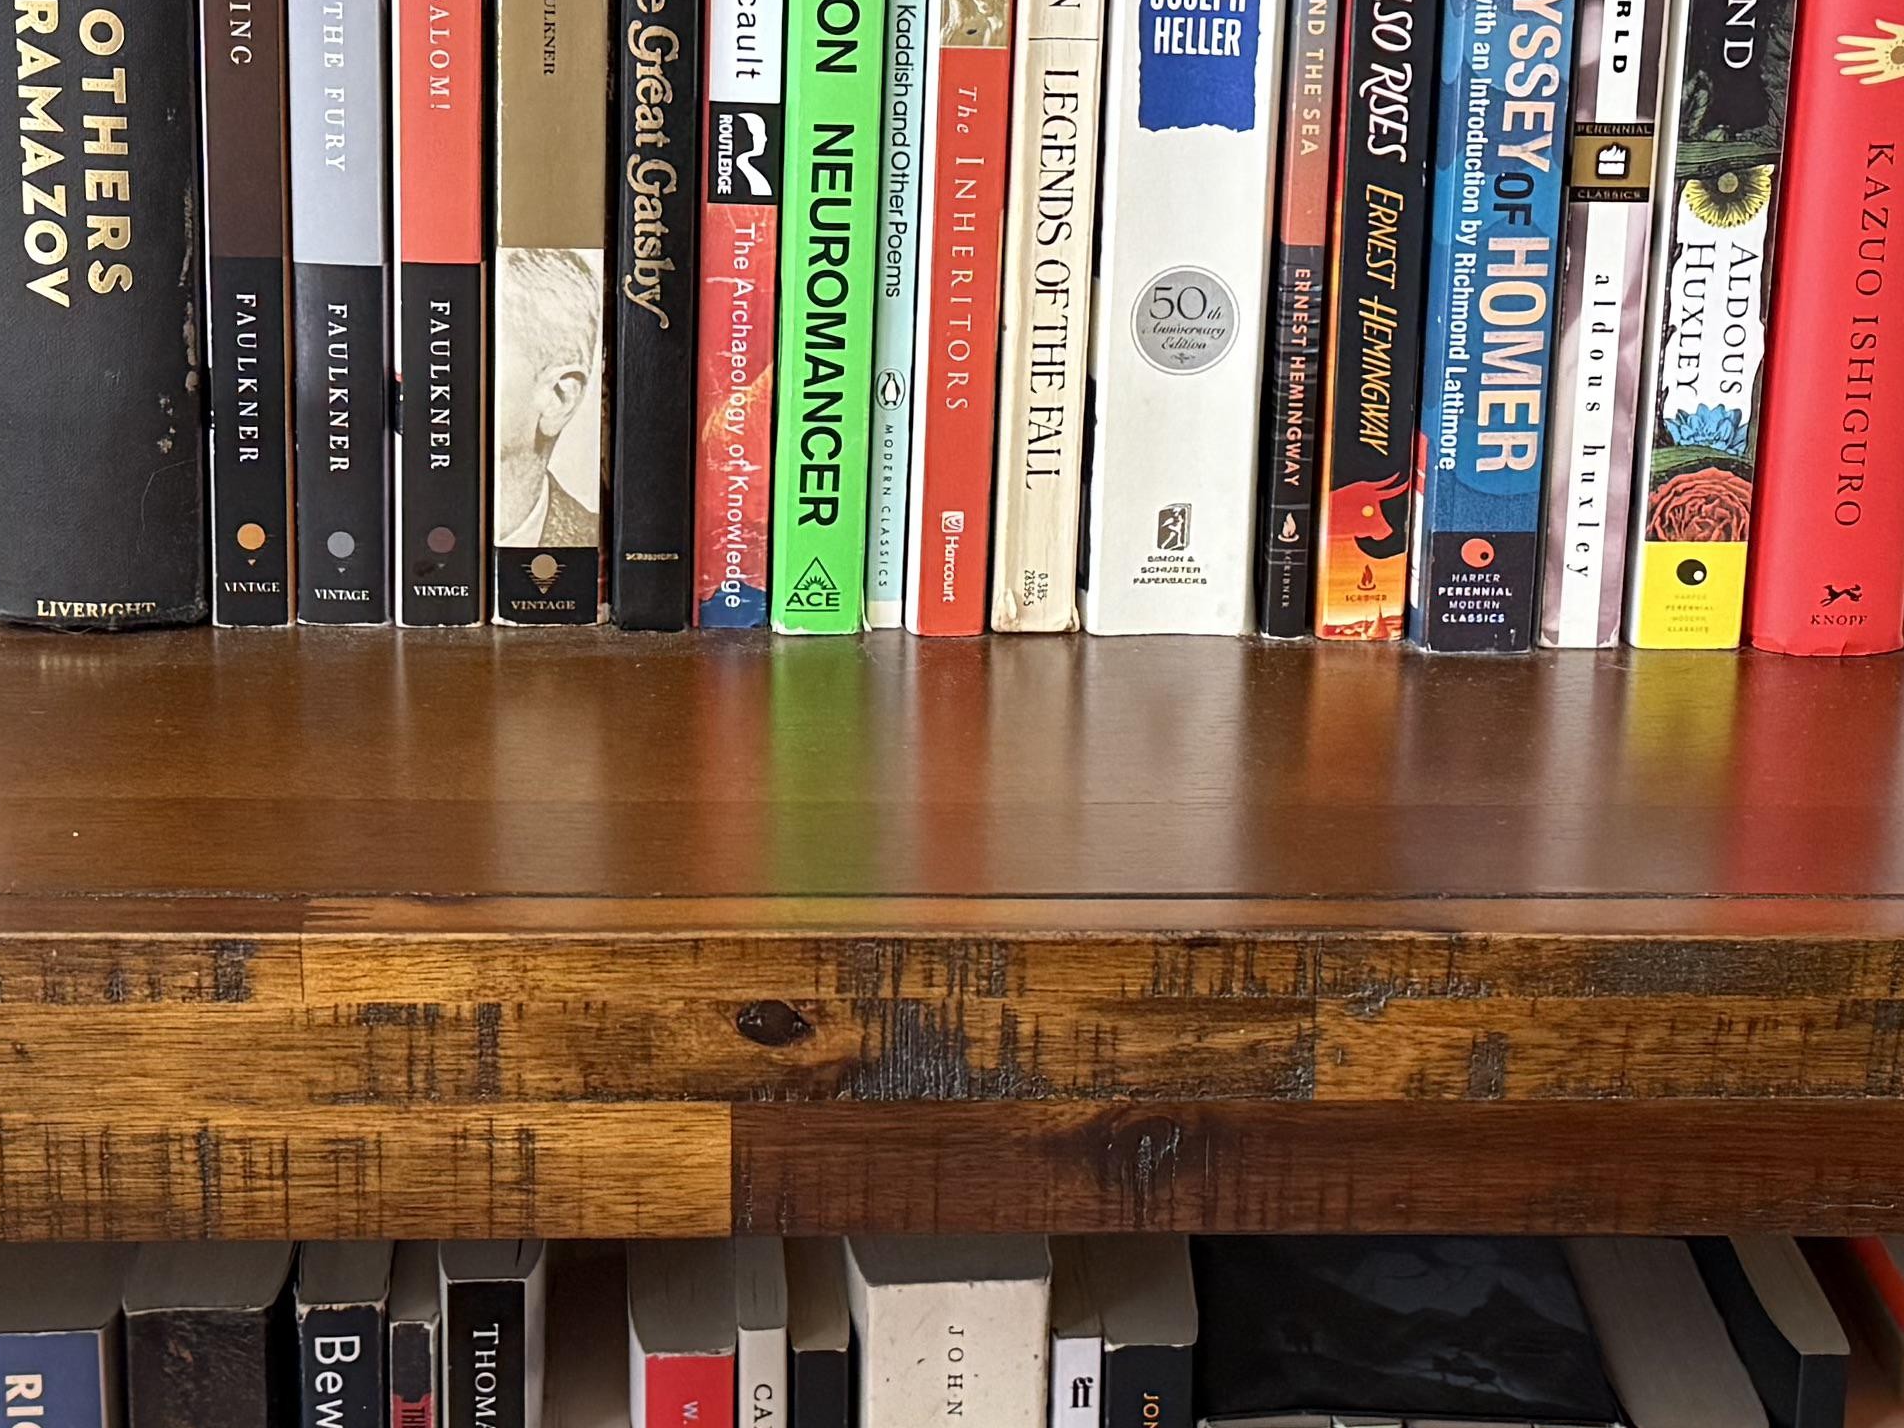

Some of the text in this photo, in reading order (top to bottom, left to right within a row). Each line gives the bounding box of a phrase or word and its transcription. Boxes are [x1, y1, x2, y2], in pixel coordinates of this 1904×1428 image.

[1153, 17, 1242, 57] HELLER
[717, 113, 734, 196] ROUTLEDGE
[1490, 172, 1536, 227] OF
[797, 122, 856, 530] NEUROMANCER
[1476, 234, 1551, 476] HOMER
[1667, 241, 1717, 396] HUXLEY
[1718, 242, 1760, 396] ALDOUS
[786, 592, 841, 608] ACE
[946, 1324, 965, 1417] JOHN
